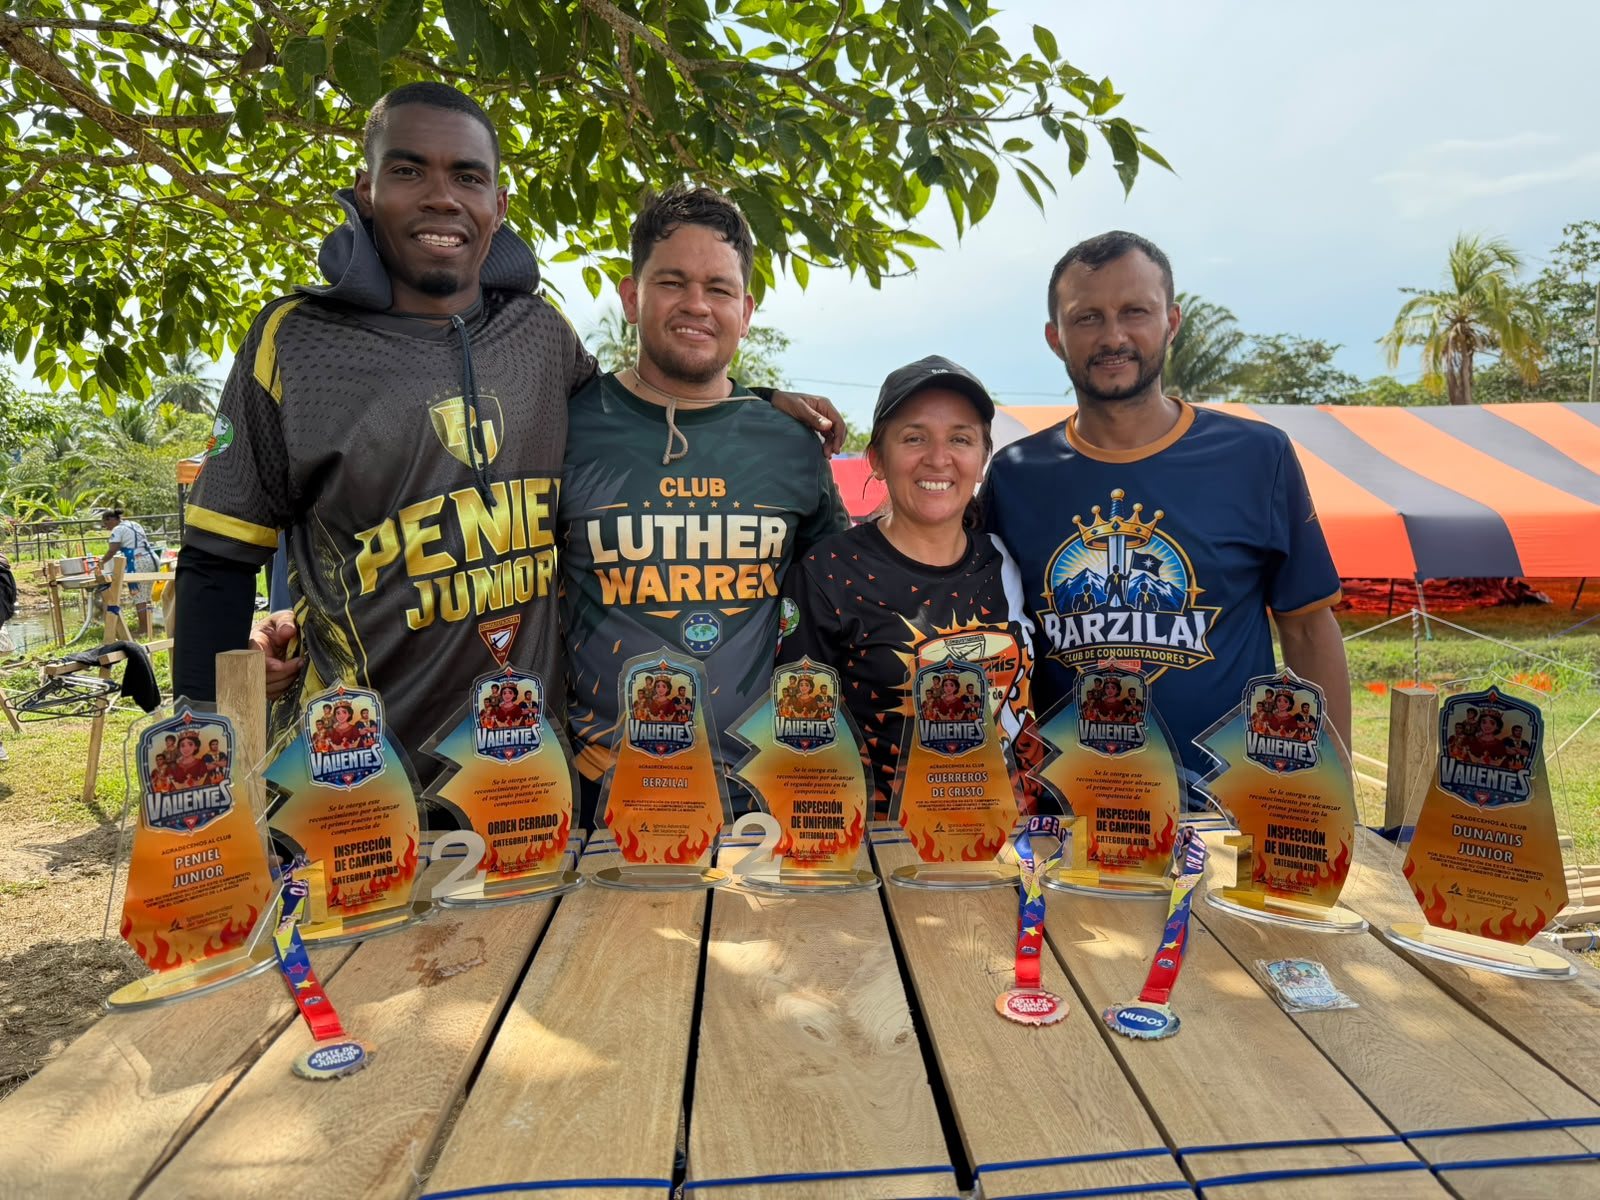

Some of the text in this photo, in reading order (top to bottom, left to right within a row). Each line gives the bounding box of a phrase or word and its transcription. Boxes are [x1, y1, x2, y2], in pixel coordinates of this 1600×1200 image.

[659, 477, 727, 498] CLUB
[354, 478, 561, 595] PENIE
[587, 514, 787, 564] LUTHER
[405, 550, 553, 630] JUNIOR
[594, 563, 780, 605] WARREN
[1043, 611, 1206, 653] BARZILAI
[1097, 648, 1185, 664] CONQUISTADORES
[476, 723, 541, 749] VALIENTES
[629, 718, 693, 742] VALIENTES
[775, 716, 836, 739] VALIENTES
[919, 719, 985, 742] VALIENTES
[1079, 719, 1146, 743] VALIENTES
[1247, 731, 1318, 762] VALIENTES
[311, 744, 382, 776] VALIENTES
[642, 777, 689, 788] BERZILAI
[927, 772, 988, 784] GUERREROS
[1441, 756, 1531, 796] VALIENTES
[148, 779, 232, 821] VALIENTES
[932, 786, 984, 798] DE CRISTO
[793, 799, 843, 814] INSPECCIÓN
[1096, 807, 1151, 822] INSPECCIÓN
[488, 813, 558, 836] ORDEN CERRADO
[791, 816, 845, 829] DE UNIFORME
[1096, 820, 1151, 835] DE CAMPING
[1450, 814, 1499, 826] AGRADECEMOS
[1509, 823, 1527, 831] CLUB
[216, 834, 231, 842] CLUB
[732, 812, 782, 874] 2
[1267, 824, 1326, 846] INSPECCIÓN
[1453, 824, 1523, 847] DUNAMIS
[175, 848, 220, 869] PENIEL
[334, 836, 392, 858] INSPECCIÓN
[1264, 839, 1328, 863] DE UNIFORME
[1459, 842, 1513, 864] JUNIOR
[334, 851, 393, 872] DE CAMPING
[431, 830, 486, 898] 2
[174, 865, 224, 888] JUNIOR
[1119, 1011, 1164, 1026] NUDOS
